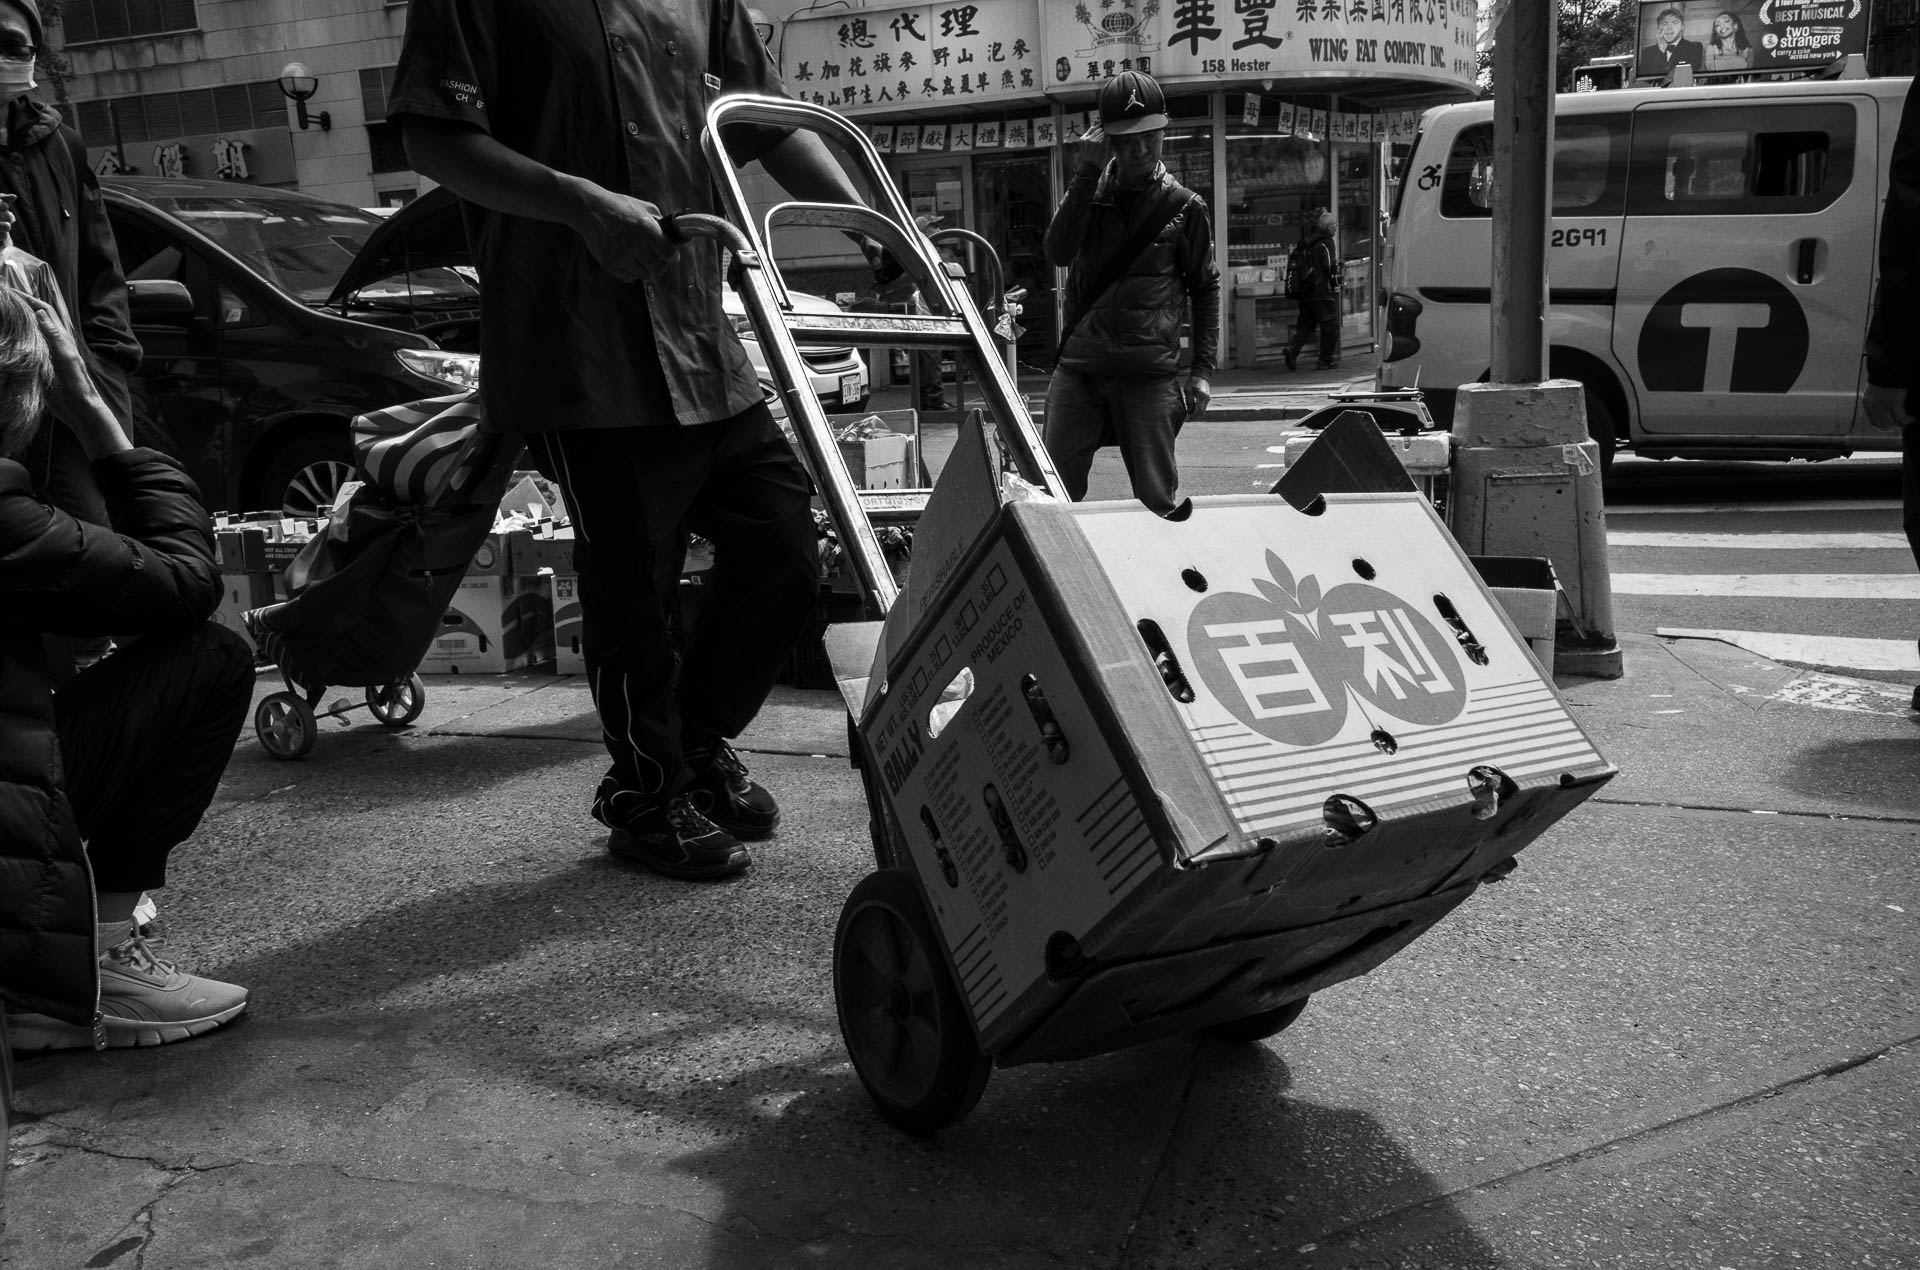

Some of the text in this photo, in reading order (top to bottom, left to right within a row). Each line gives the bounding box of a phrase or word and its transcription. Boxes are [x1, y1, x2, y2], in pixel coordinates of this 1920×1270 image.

[837, 5, 980, 48] 總代理
[1775, 6, 1845, 22] BEST MUSICAL
[1786, 25, 1810, 37] two
[1309, 38, 1348, 62] WING
[1356, 39, 1378, 62] FAT
[1384, 40, 1426, 65] COMPNY
[1430, 45, 1446, 69] INC.
[1780, 34, 1841, 48] strangers
[1201, 58, 1271, 73] 158 Hester
[440, 78, 478, 95] FASHION
[1551, 228, 1607, 248] 2G91
[919, 536, 966, 612] PERISHABLE
[970, 604, 1014, 665] PRODUCE
[1012, 587, 1028, 612] OF
[986, 613, 1024, 666] MEXICO
[1203, 608, 1456, 720] 百利
[874, 711, 899, 758] NET WT.
[882, 717, 925, 796] BALLY
